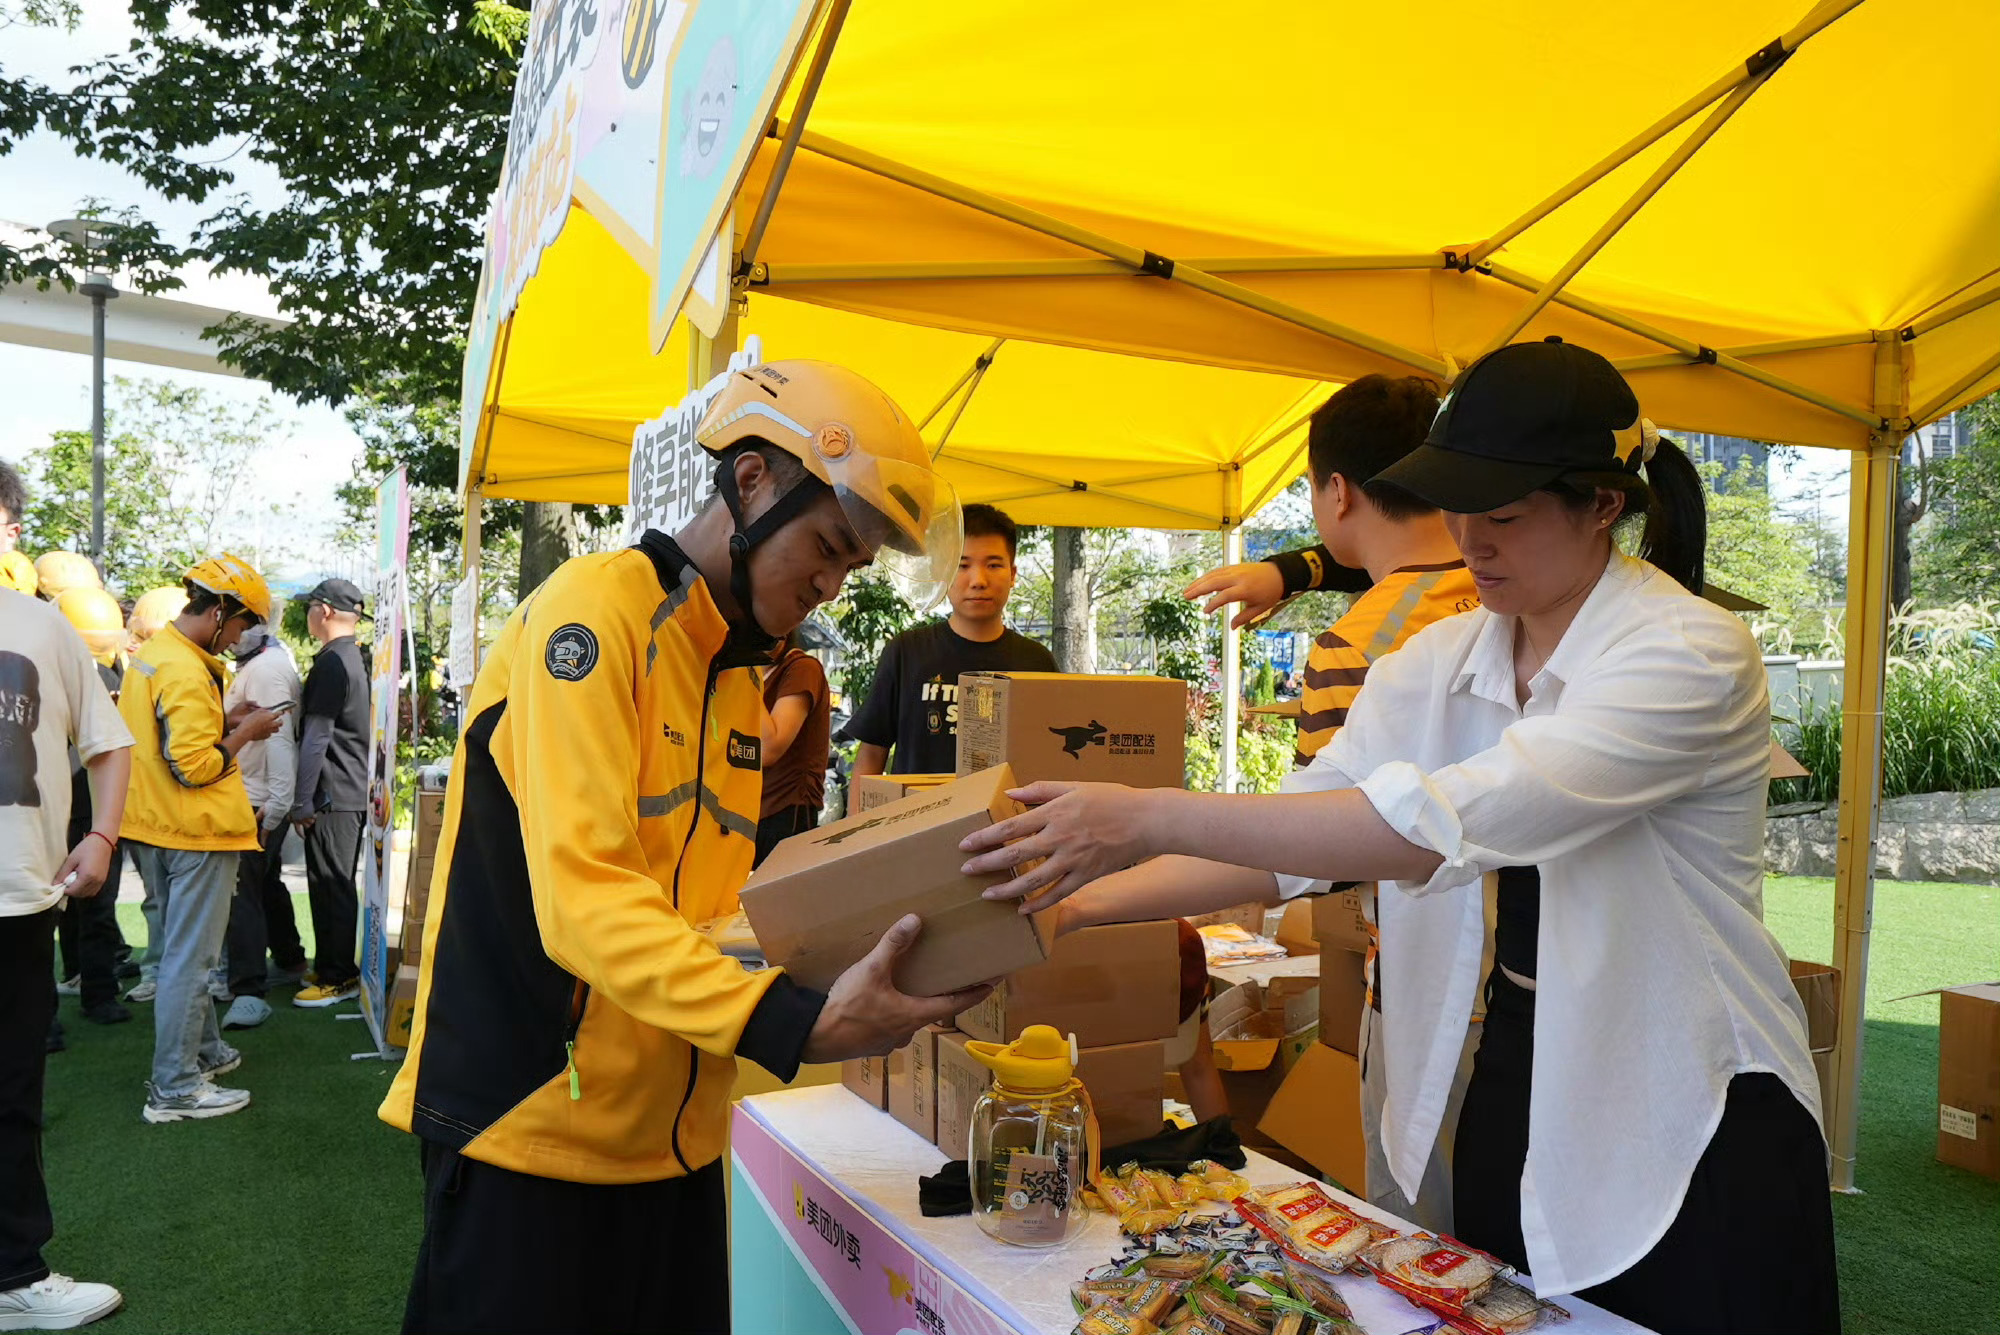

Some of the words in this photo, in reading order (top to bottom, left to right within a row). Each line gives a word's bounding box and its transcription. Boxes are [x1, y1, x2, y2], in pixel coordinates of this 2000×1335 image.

[922, 683, 939, 701] If
[1109, 733, 1155, 747] 美团配送
[806, 1196, 861, 1270] 美团外卖
